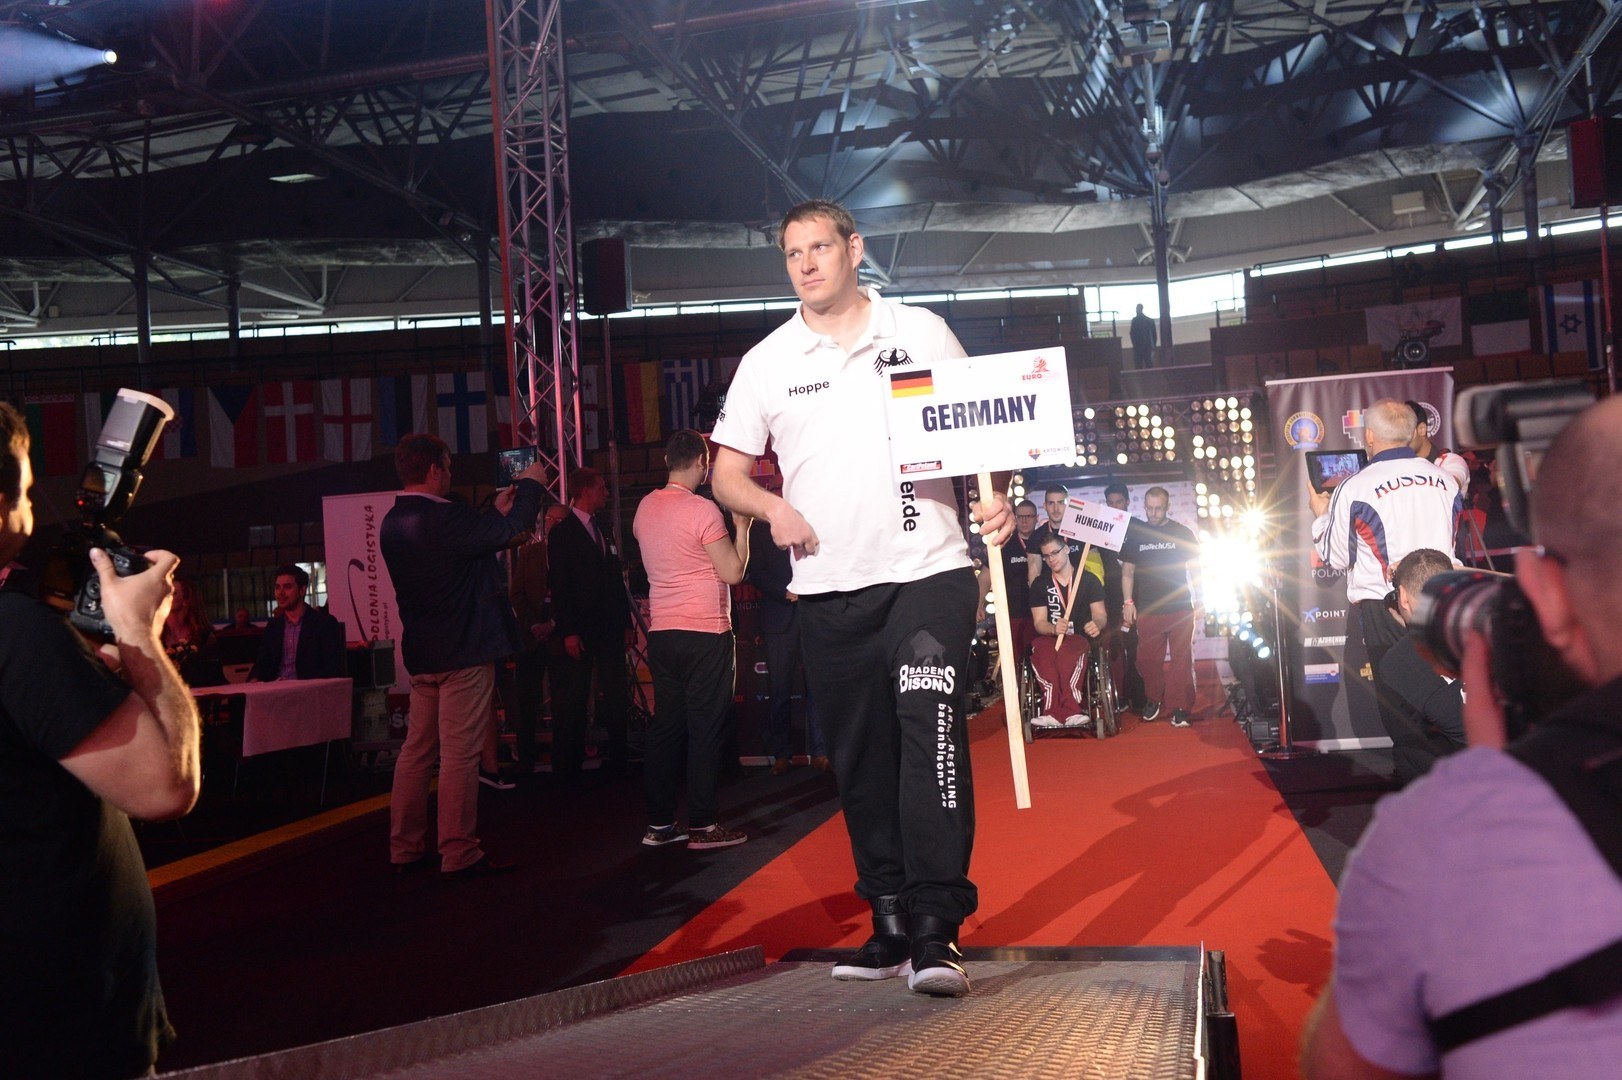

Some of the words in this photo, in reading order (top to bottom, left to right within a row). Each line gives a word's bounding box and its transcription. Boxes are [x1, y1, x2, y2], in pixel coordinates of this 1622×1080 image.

[1022, 373, 1043, 381] EURO
[788, 380, 830, 397] Hoppe
[922, 394, 1038, 432] GERMANY
[1374, 474, 1448, 499] RUSSIA
[1075, 513, 1115, 533] HUNGARY
[364, 505, 378, 580] LOGISTYKA
[1139, 542, 1176, 552] BioTechUSA
[900, 664, 956, 695] BISONS
[909, 666, 945, 677] BADEN
[936, 703, 947, 808] badenbisons.de
